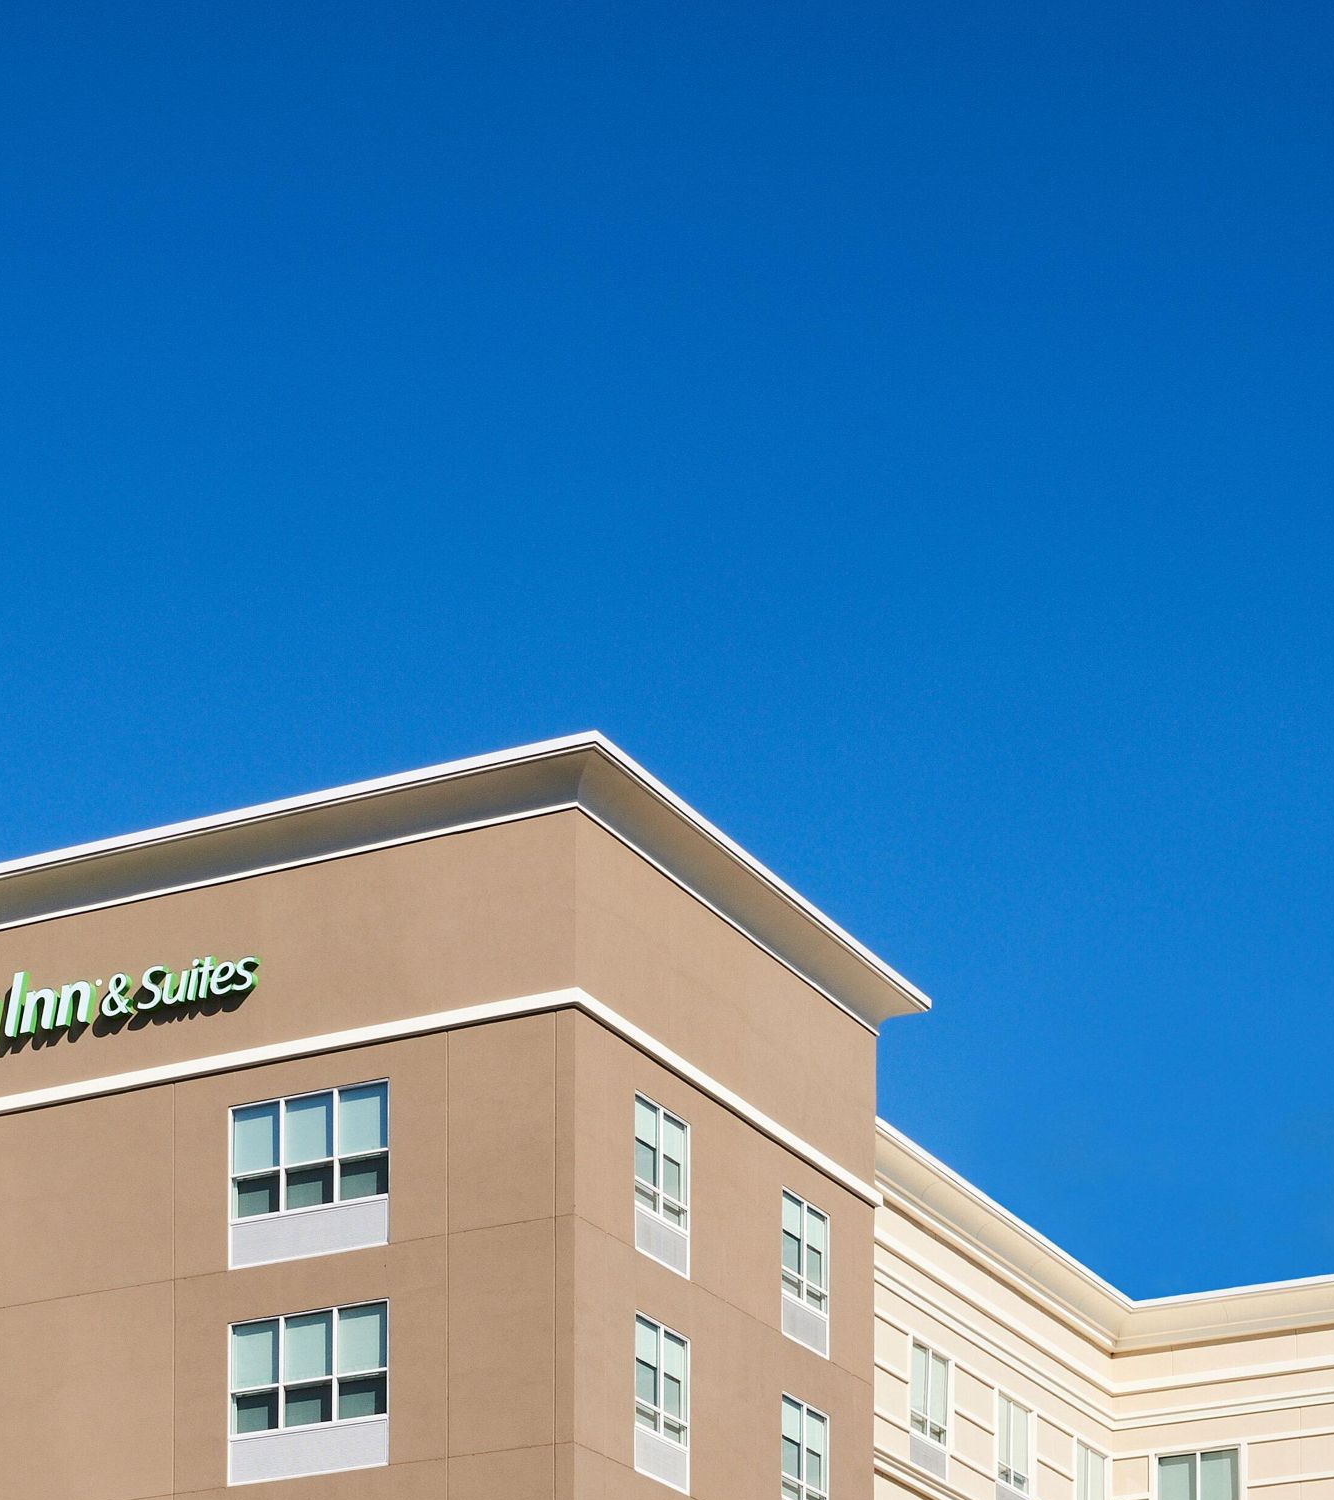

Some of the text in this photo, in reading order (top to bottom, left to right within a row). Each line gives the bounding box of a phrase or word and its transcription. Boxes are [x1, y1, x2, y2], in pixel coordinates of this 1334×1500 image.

[5, 971, 94, 1037] Inn
[101, 973, 134, 1017] &
[136, 955, 260, 1011] Suites
